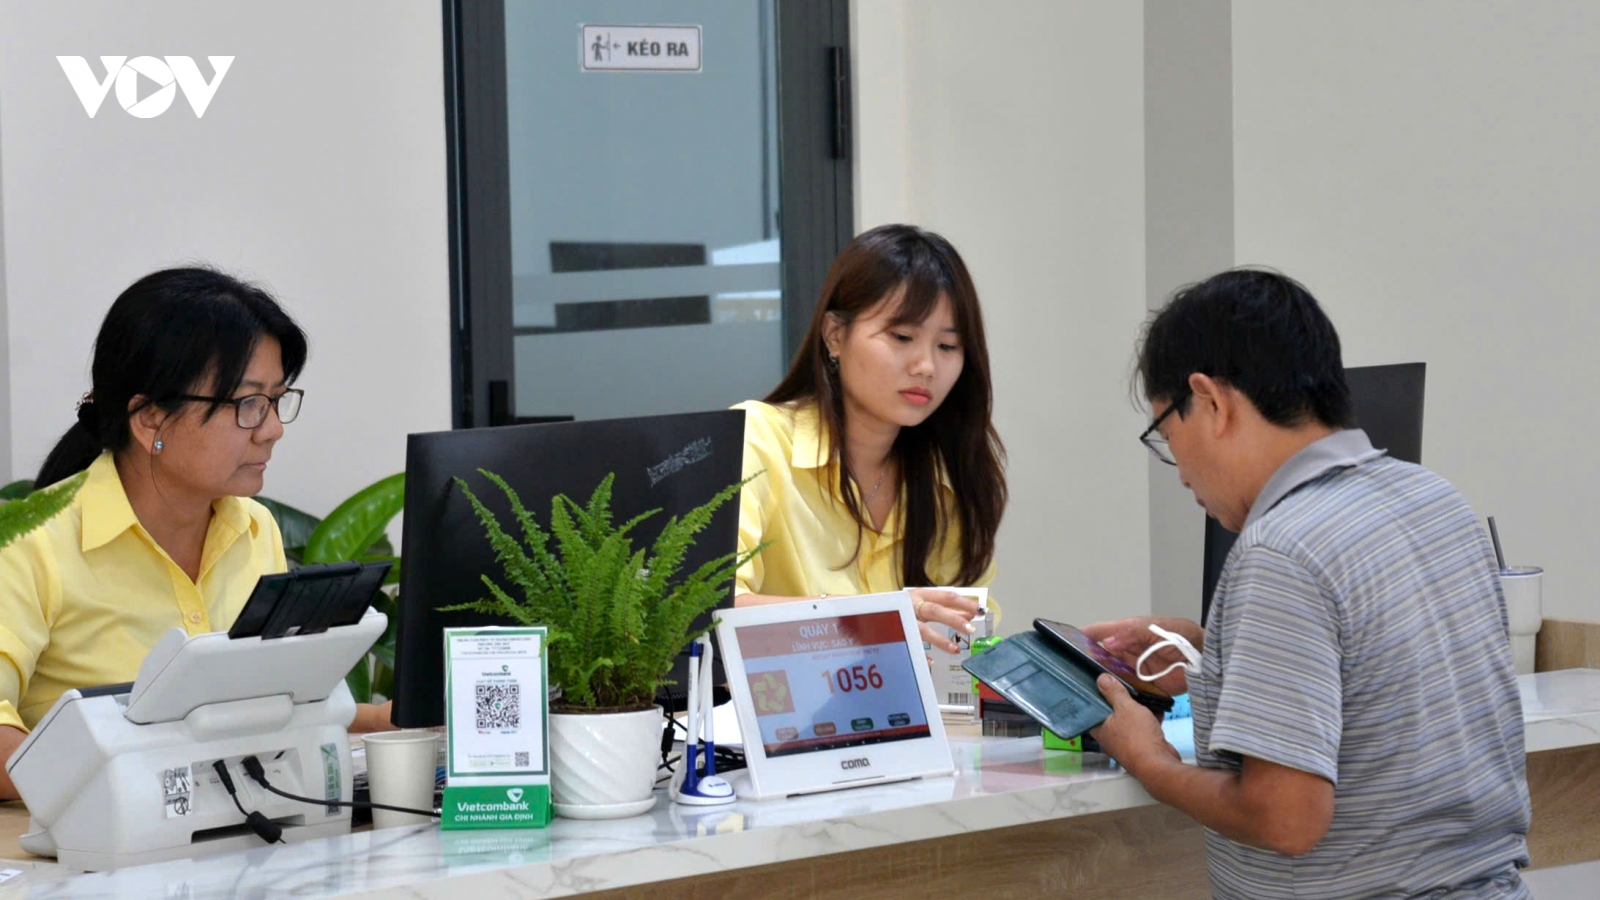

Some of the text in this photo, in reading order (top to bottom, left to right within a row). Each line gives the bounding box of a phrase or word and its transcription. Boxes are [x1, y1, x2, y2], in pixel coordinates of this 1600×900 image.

[627, 39, 689, 56] KÉO RA
[832, 623, 840, 636] 1
[831, 638, 847, 648] SAO
[821, 664, 884, 694] 1056
[457, 801, 529, 812] Vietcombank
[454, 812, 534, 822] CHI NHÁNH GIA ĐỊNH
